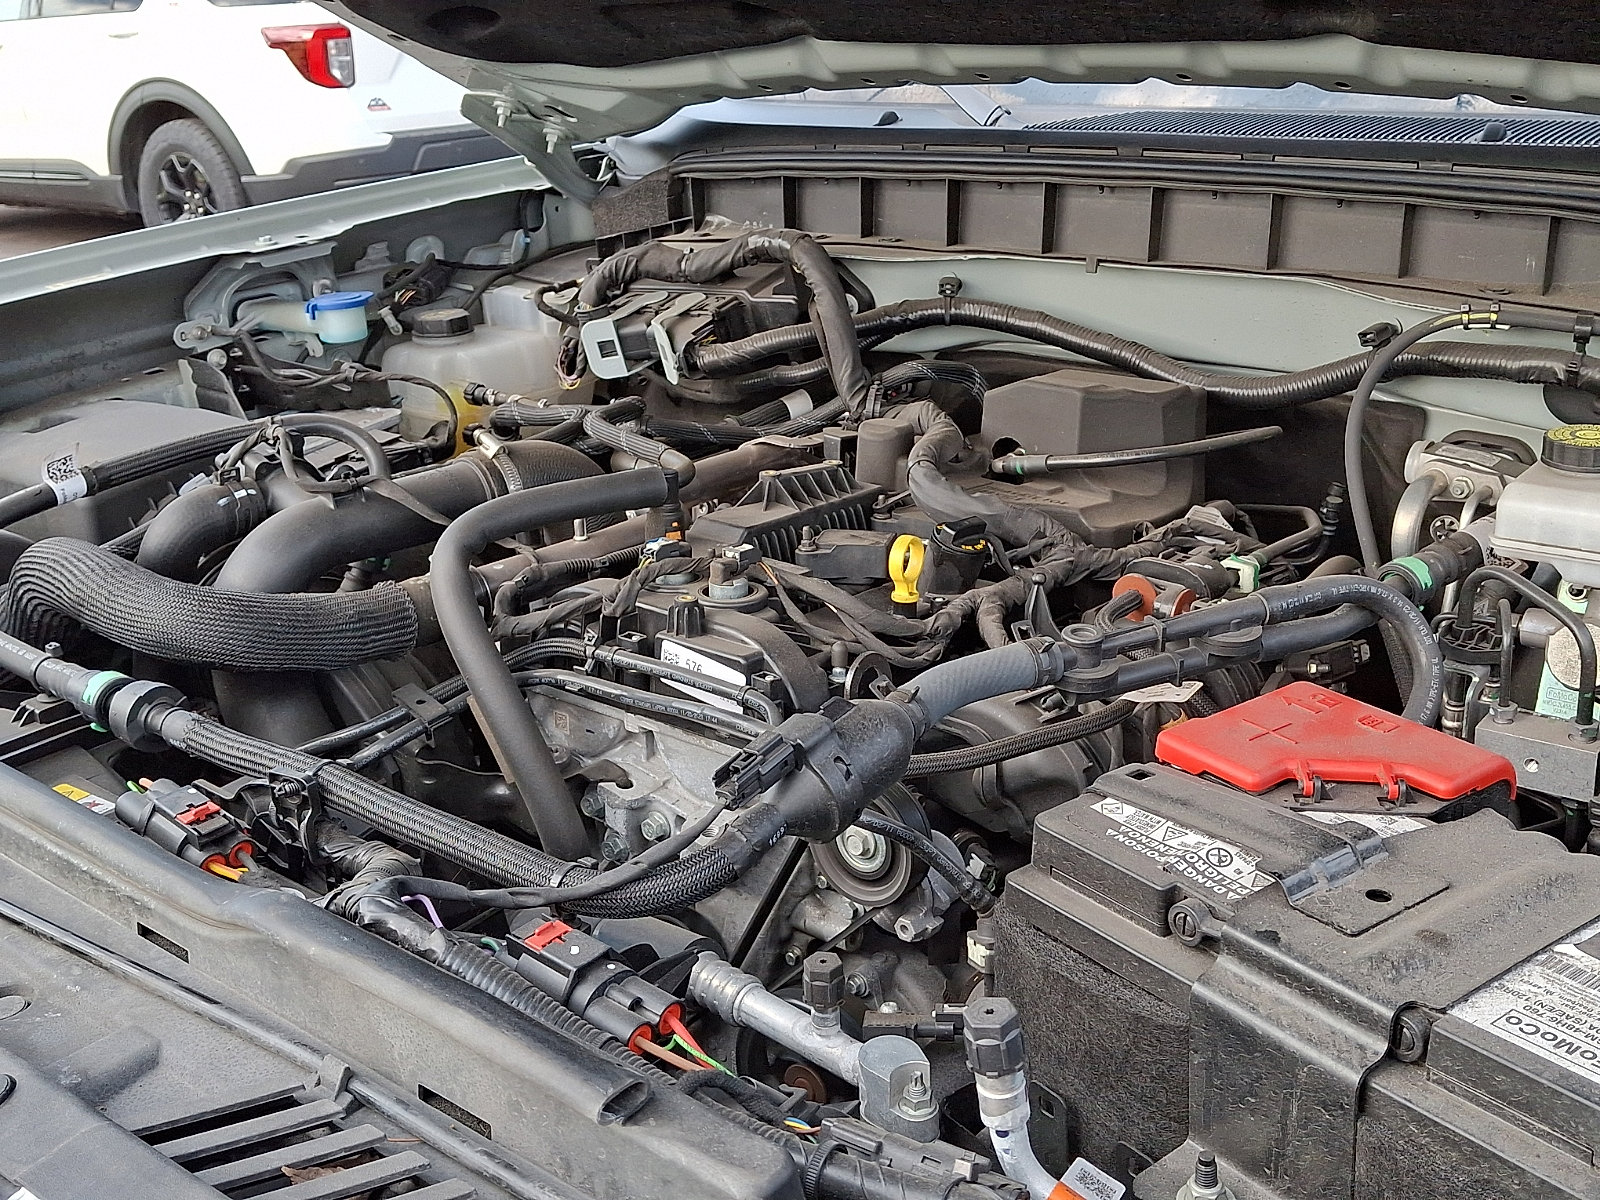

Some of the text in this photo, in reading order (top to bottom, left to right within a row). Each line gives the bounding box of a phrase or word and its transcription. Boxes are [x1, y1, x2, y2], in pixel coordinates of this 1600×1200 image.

[1114, 834, 1169, 863] POISON
[1168, 854, 1228, 895] DANGER
[1184, 851, 1252, 896] PELIGRO
[1533, 999, 1588, 1026] (SAE/EN)
